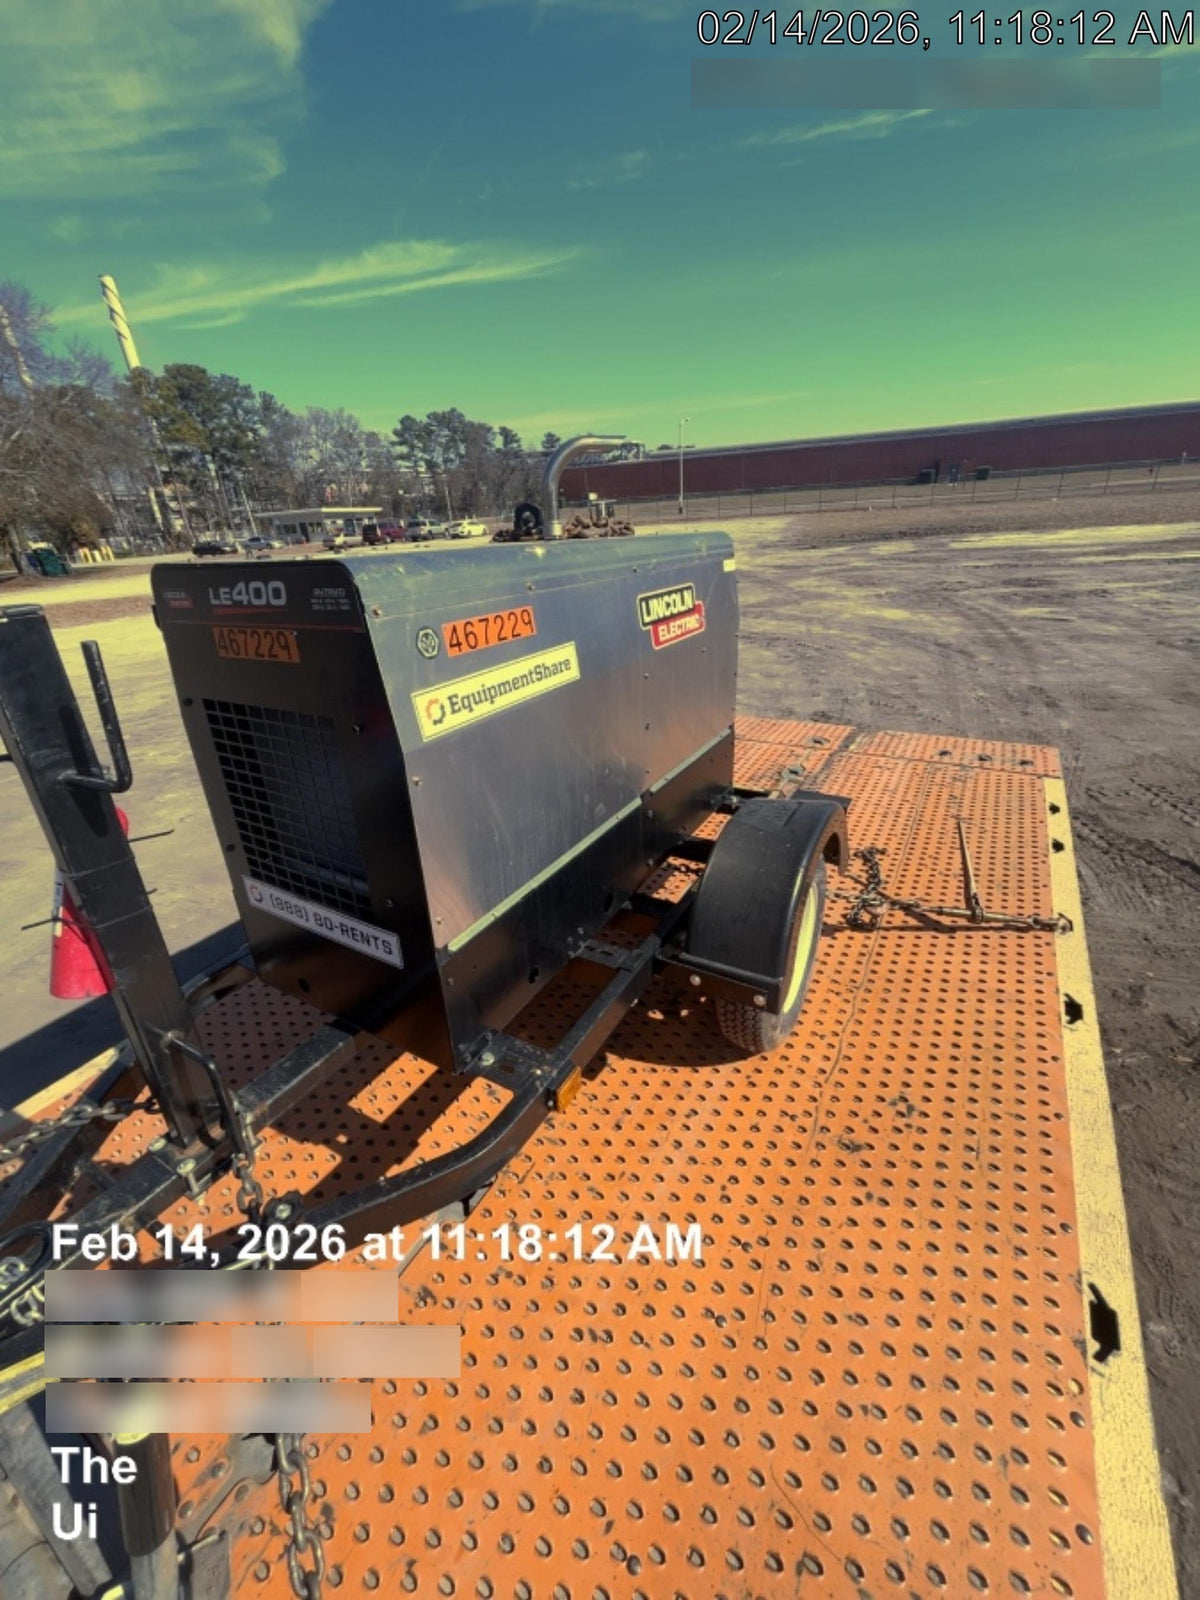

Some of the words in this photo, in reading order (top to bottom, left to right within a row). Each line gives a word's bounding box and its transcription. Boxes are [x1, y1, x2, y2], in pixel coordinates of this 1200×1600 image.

[208, 581, 287, 606] LE400
[641, 589, 694, 623] LINCOLN
[217, 628, 293, 660] 467229
[449, 609, 534, 652] 467229
[657, 613, 702, 643] ELECTRIC
[447, 657, 571, 715] EquipmentShare
[269, 894, 310, 922] (888)
[313, 912, 393, 955] 80-RENTS
